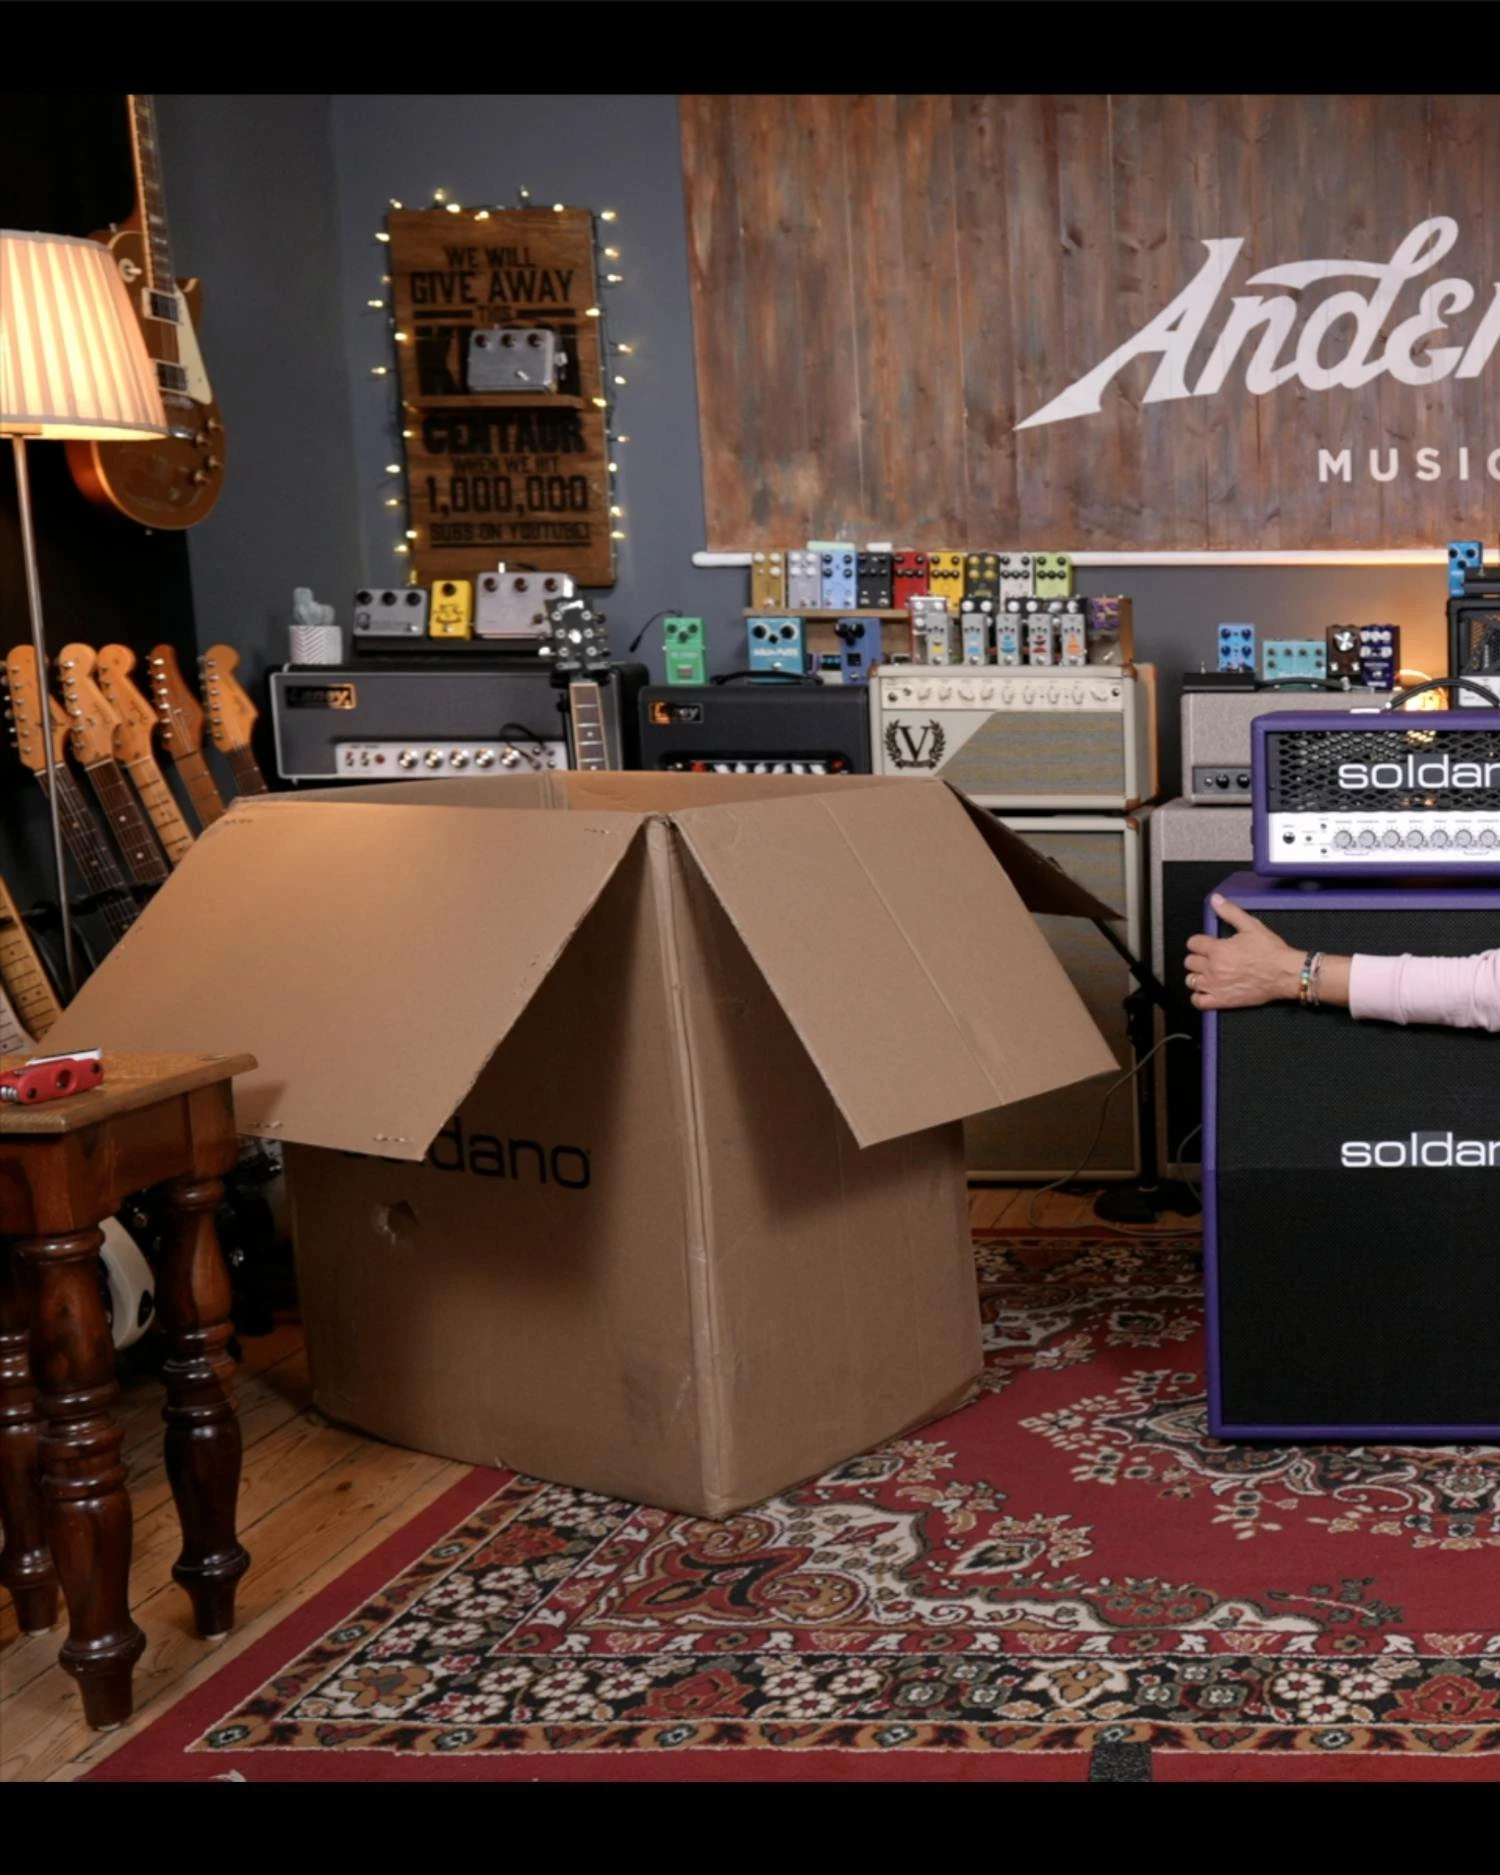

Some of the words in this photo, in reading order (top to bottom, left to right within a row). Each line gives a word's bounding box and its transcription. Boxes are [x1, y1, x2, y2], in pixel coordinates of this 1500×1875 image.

[445, 246, 477, 268] WE
[485, 246, 535, 268] WILL
[411, 272, 476, 304] GIVE
[489, 269, 573, 302] AWAY
[426, 474, 588, 517] 1,000,000
[342, 1115, 591, 1190] dano
